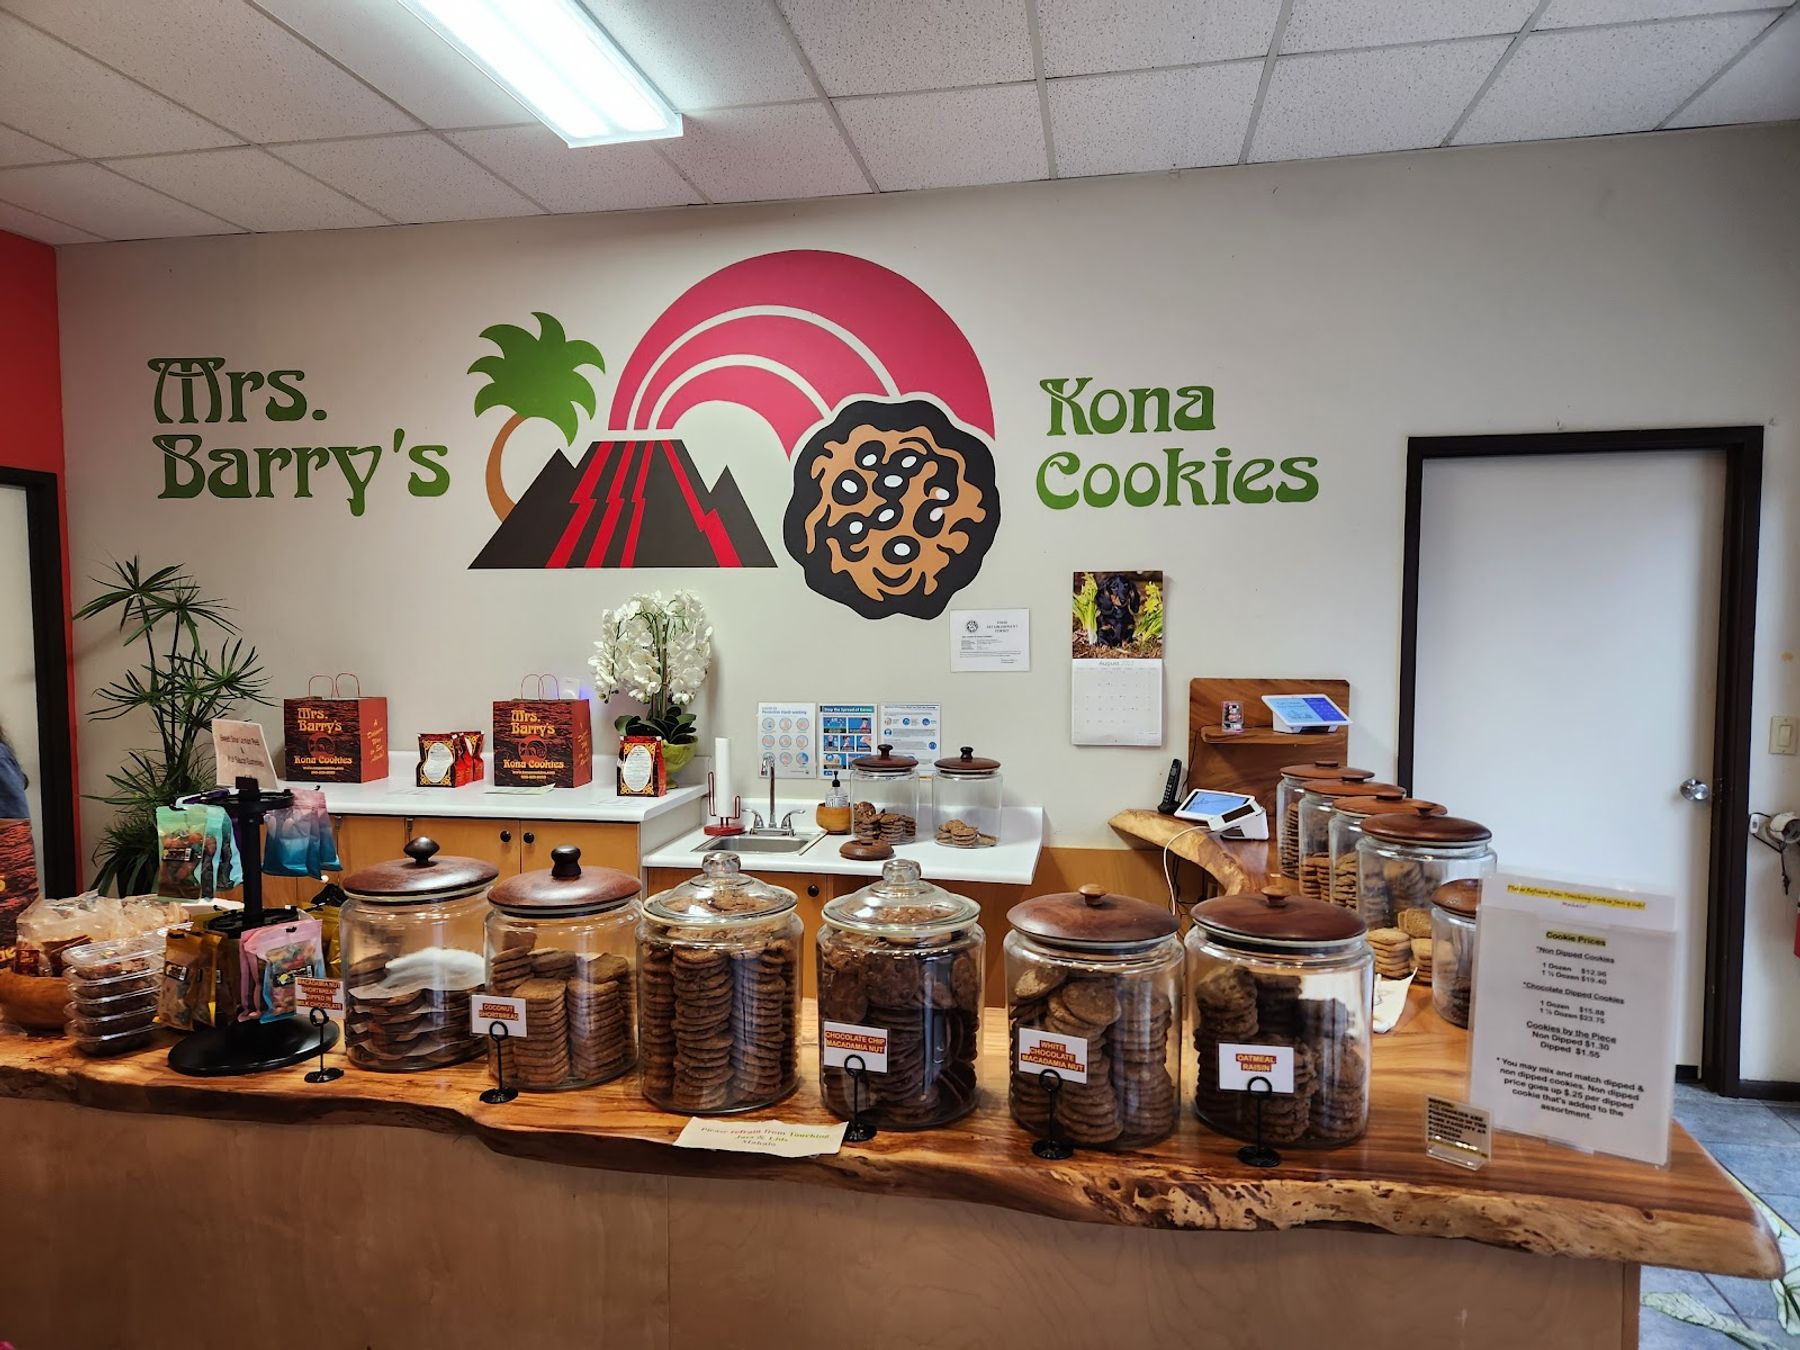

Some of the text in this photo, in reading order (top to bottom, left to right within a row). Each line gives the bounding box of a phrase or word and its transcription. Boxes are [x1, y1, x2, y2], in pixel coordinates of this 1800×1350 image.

[148, 357, 327, 423] Mrs.
[1040, 377, 1216, 436] Kona
[152, 428, 450, 517] Barry's
[1036, 448, 1319, 510] Cookies
[297, 708, 328, 719] Mrs.
[511, 710, 540, 722] Mrs.
[298, 720, 342, 734] Barry's
[511, 722, 555, 736] Barry's
[294, 756, 316, 764] Kona
[503, 759, 564, 768] Kona Cookies
[1546, 931, 1606, 947] Cookie Prices
[1556, 949, 1582, 959] Dipped
[1584, 953, 1615, 964] Cookies
[1548, 963, 1571, 972] Dozen
[298, 979, 328, 987] MACADAMIA
[1556, 972, 1579, 980] Dozen
[1565, 989, 1592, 999] Dipped
[1594, 993, 1624, 1004] Cookies
[310, 1001, 342, 1009] CHOCOLATE
[1546, 1001, 1569, 1010] Dozen
[479, 1011, 519, 1020] SHORTBREAD
[1554, 1010, 1578, 1019] Dozen
[1579, 1014, 1605, 1024] $23.75
[825, 1031, 885, 1045] CHOCOLATE CHIP
[1526, 1020, 1616, 1044] Cookies by the Piece
[827, 1040, 868, 1051] MACADAMIA
[1041, 1041, 1065, 1051] WHITE
[1532, 1031, 1609, 1051] Non Dipped $1.30
[1030, 1048, 1074, 1061] CHOCOLATE
[1540, 1041, 1600, 1058] Dipped $1.55
[1022, 1054, 1066, 1068] MACADAMIA
[1237, 1054, 1274, 1063] OATMEAL
[1242, 1063, 1270, 1071] RAISIN
[1502, 1058, 1517, 1067] You
[1519, 1063, 1537, 1072] may
[1574, 1074, 1601, 1083] match
[1604, 1079, 1635, 1090] dipped
[1518, 1071, 1547, 1082] dipped
[1549, 1078, 1584, 1090] cookies.
[1588, 1084, 1605, 1094] Non
[1608, 1089, 1639, 1101] dipped
[1504, 1078, 1526, 1087] price
[1528, 1083, 1549, 1091] goes
[1564, 1088, 1583, 1099] $.25
[1602, 1098, 1634, 1109] dipped
[1512, 1089, 1540, 1099] cookie
[1542, 1094, 1566, 1104] that's
[1569, 1100, 1596, 1111] added
[1609, 1108, 1624, 1116] the
[1541, 1104, 1592, 1120] assortment.
[1446, 1119, 1475, 1131] FACILITY
